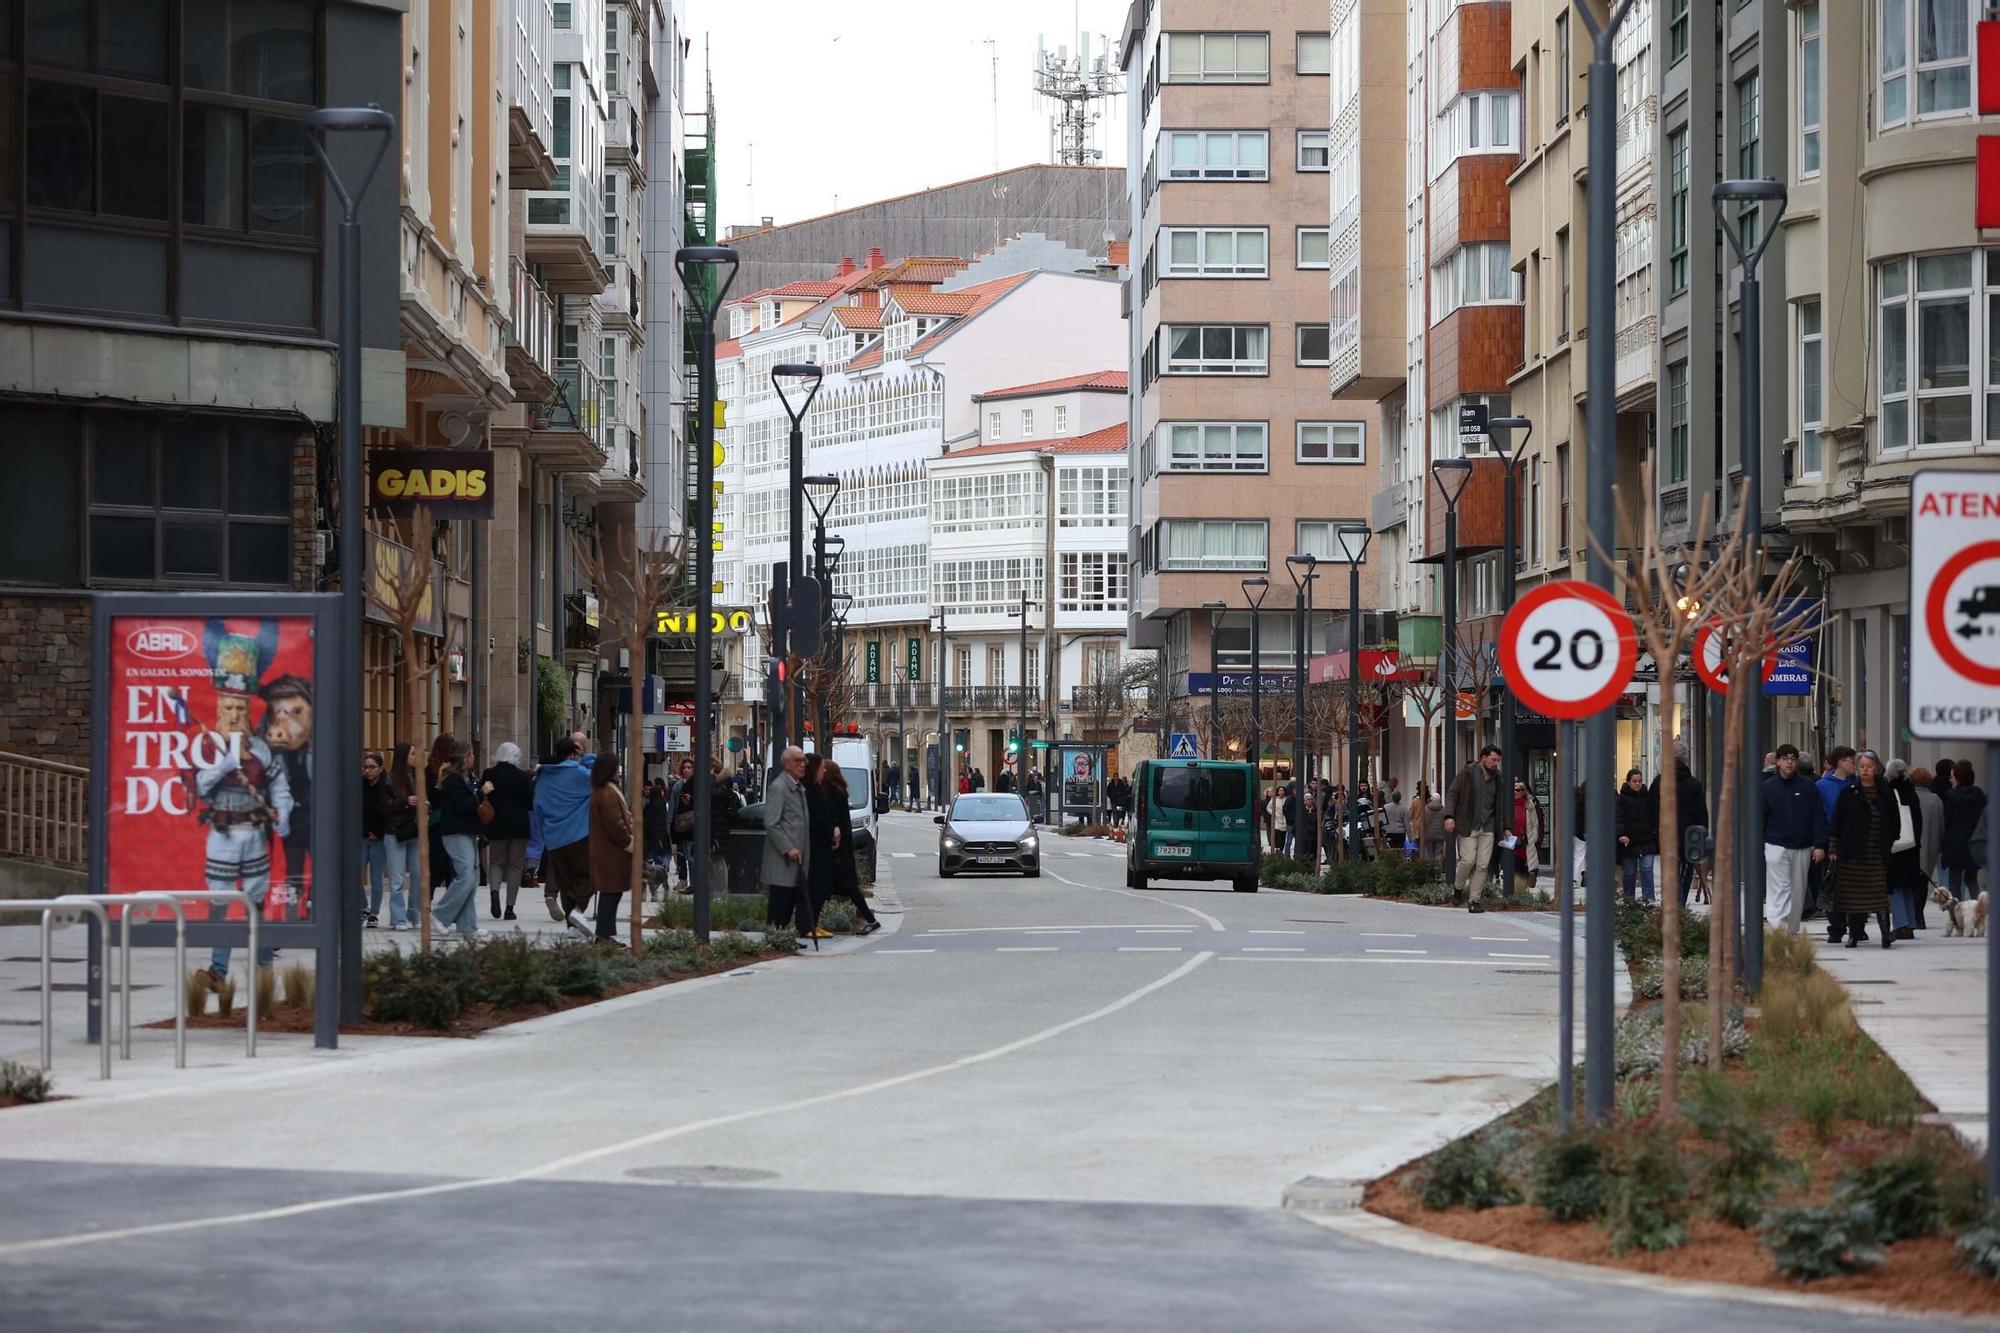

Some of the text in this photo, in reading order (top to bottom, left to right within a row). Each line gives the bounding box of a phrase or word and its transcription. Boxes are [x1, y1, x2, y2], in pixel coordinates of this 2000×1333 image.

[377, 468, 488, 499] GADIS
[1919, 491, 2000, 518] ATEN
[135, 633, 189, 652] ABRIL
[1531, 628, 1604, 671] 20
[125, 667, 139, 677] EN
[1778, 659, 1797, 668] LAS
[125, 685, 191, 724] EN
[125, 731, 244, 770] TROI
[1159, 847, 1176, 855] 7823
